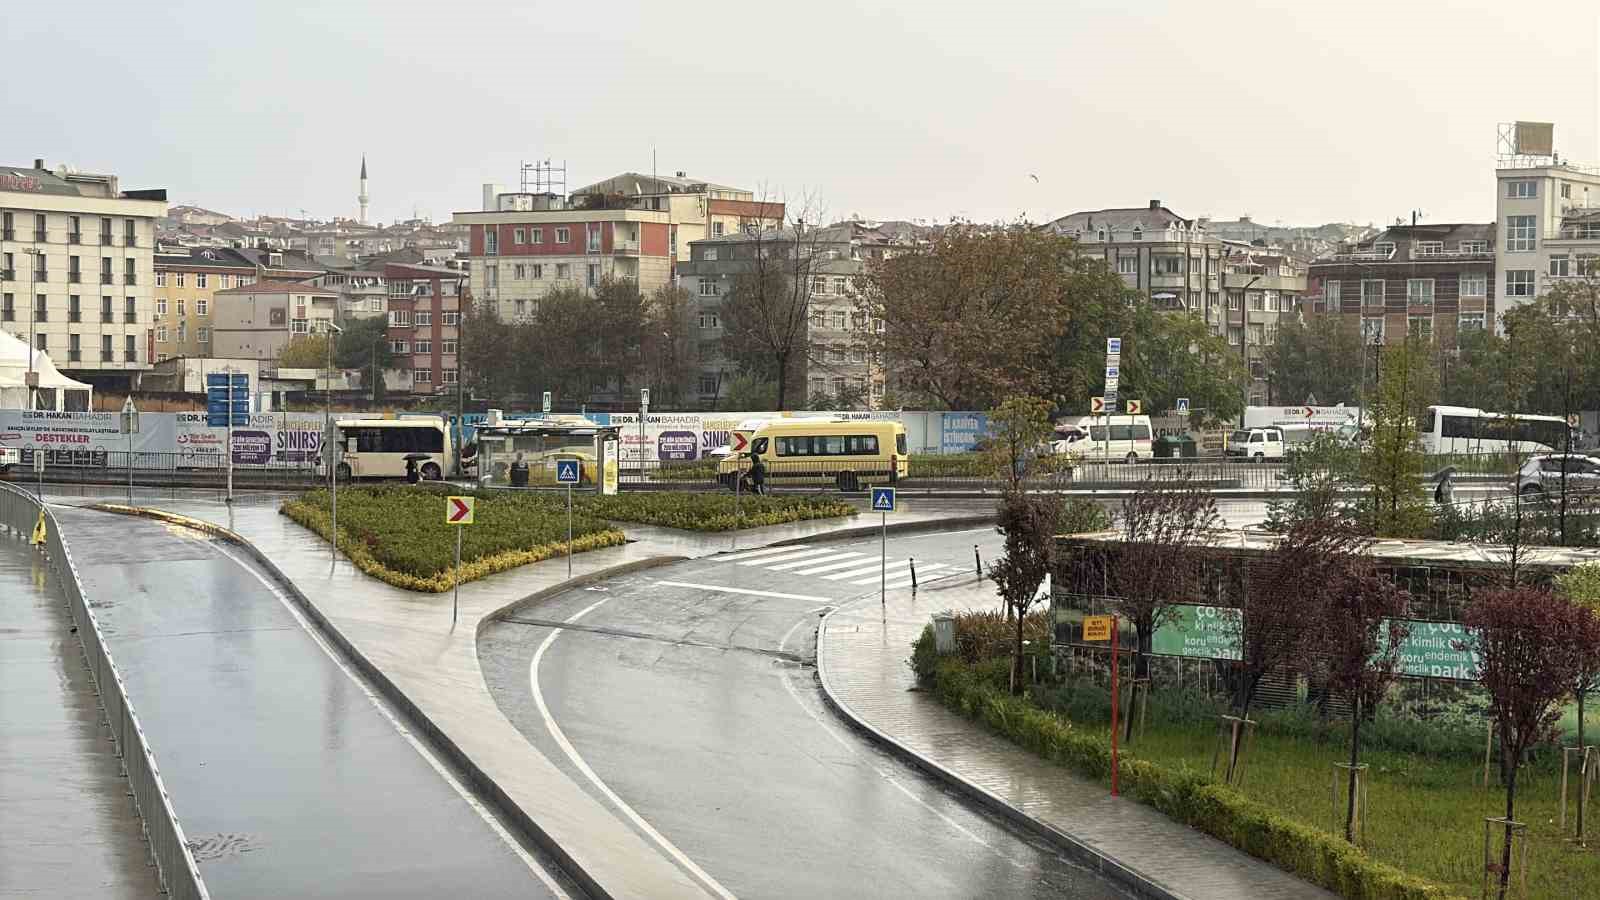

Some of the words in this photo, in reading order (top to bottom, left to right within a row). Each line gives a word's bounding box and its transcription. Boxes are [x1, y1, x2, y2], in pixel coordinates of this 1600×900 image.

[46, 411, 72, 420] HAKAN
[187, 414, 200, 422] DR.
[251, 415, 274, 423] ADIR
[623, 416, 634, 424] DR.
[635, 416, 661, 424] HKAN
[661, 416, 700, 424] BAHADIR
[35, 433, 90, 443] DESTEKLER
[277, 431, 321, 449] SINIRSI
[1184, 635, 1206, 646] koru
[1411, 636, 1446, 649] kimlik
[1400, 653, 1424, 663] koru
[1424, 650, 1469, 662] endemik
